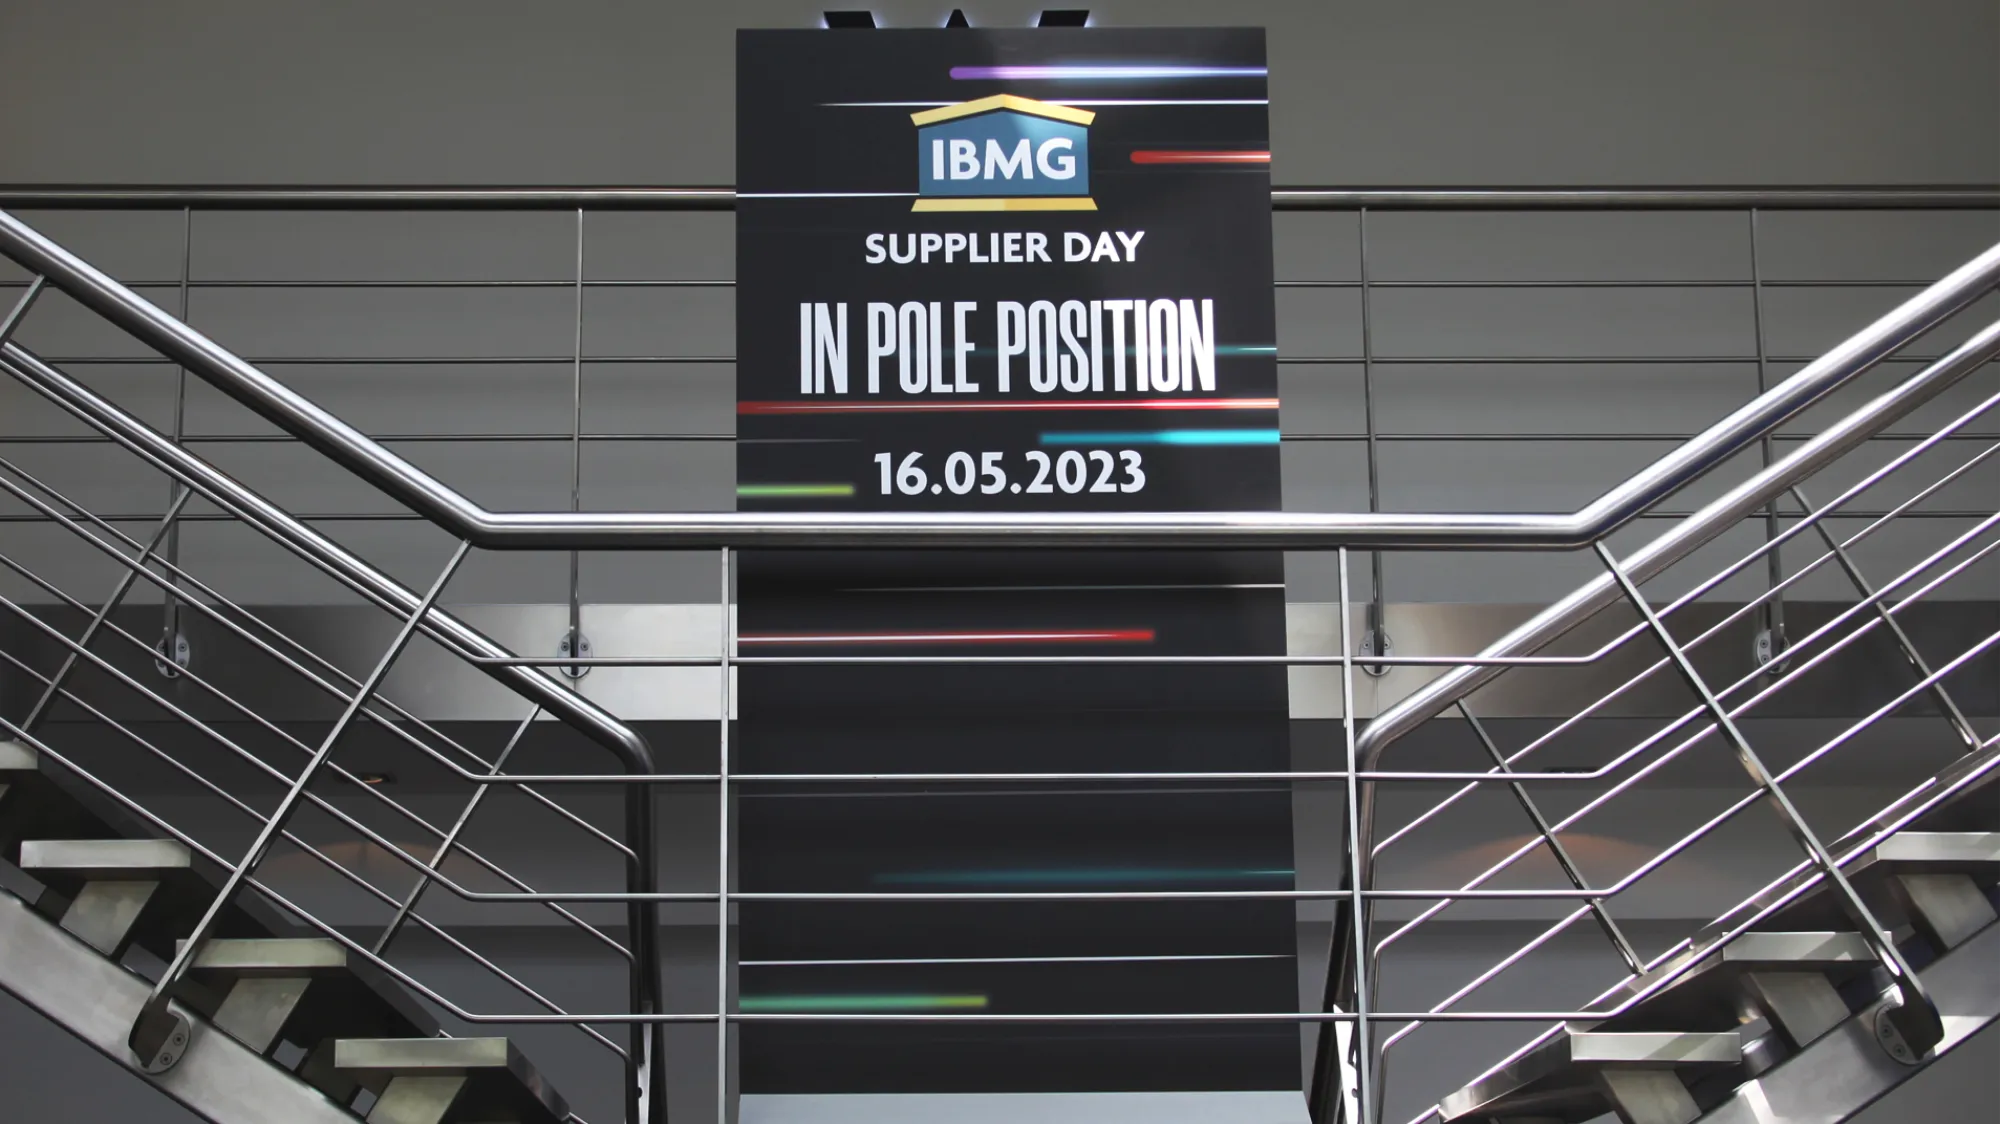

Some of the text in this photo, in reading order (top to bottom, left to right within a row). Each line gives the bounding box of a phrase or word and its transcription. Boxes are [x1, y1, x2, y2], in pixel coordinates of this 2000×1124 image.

[931, 137, 1076, 180] IBMG
[865, 231, 1145, 264] SUPPLIER DAY
[800, 299, 1217, 394] IN POLE POSITION
[873, 450, 1146, 495] 16.05.2023
